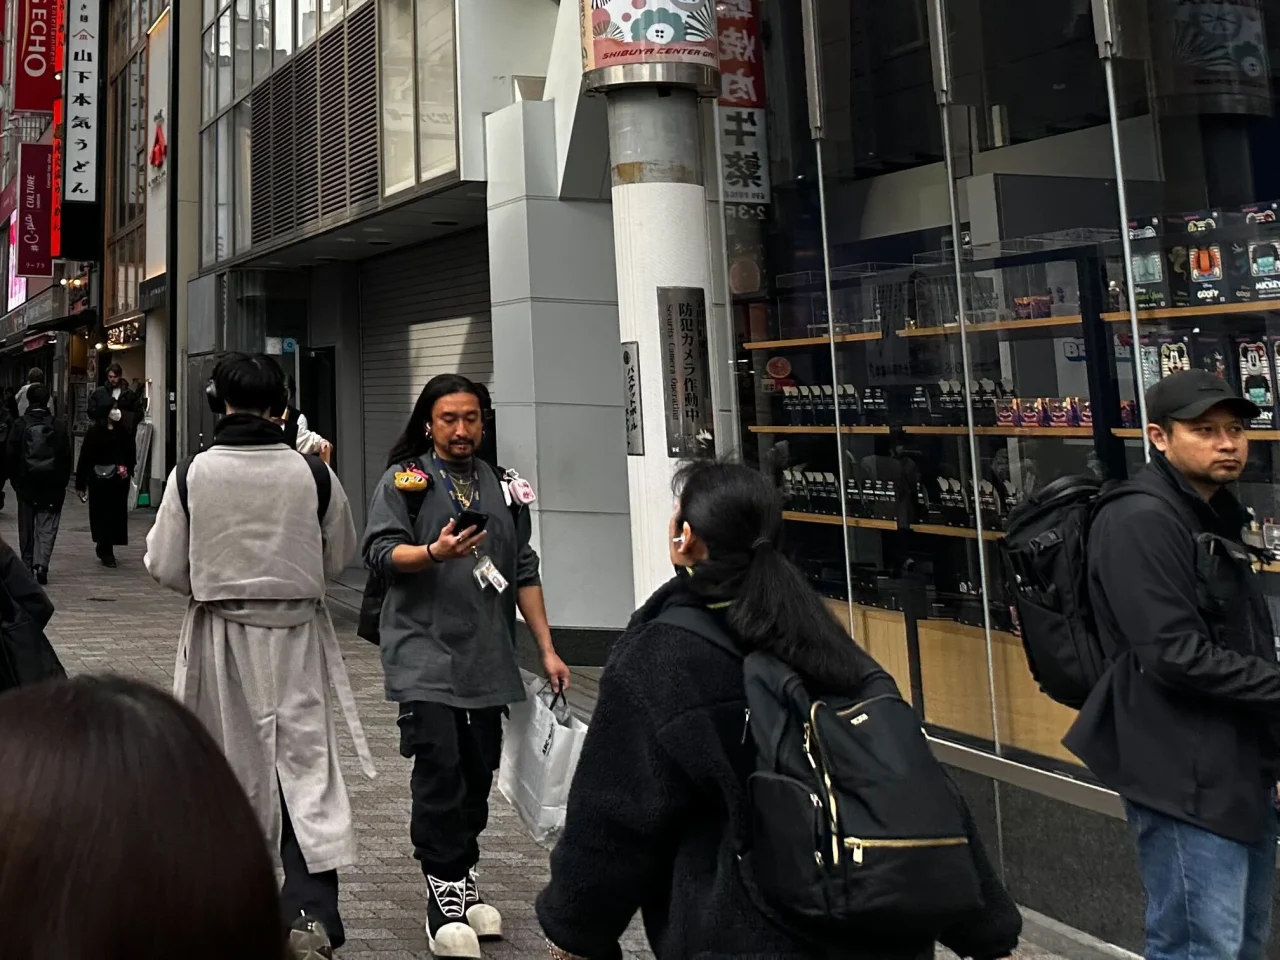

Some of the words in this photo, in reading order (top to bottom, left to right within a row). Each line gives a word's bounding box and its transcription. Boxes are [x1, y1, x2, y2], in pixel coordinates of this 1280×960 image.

[24, 8, 48, 78] ECHO
[602, 48, 654, 60] SHIBUYA
[71, 49, 92, 193] 山下本気うどん
[25, 174, 35, 208] CULTURE
[678, 302, 700, 423] 防犯カメラ作動中
[627, 365, 638, 431] バスケットボール
